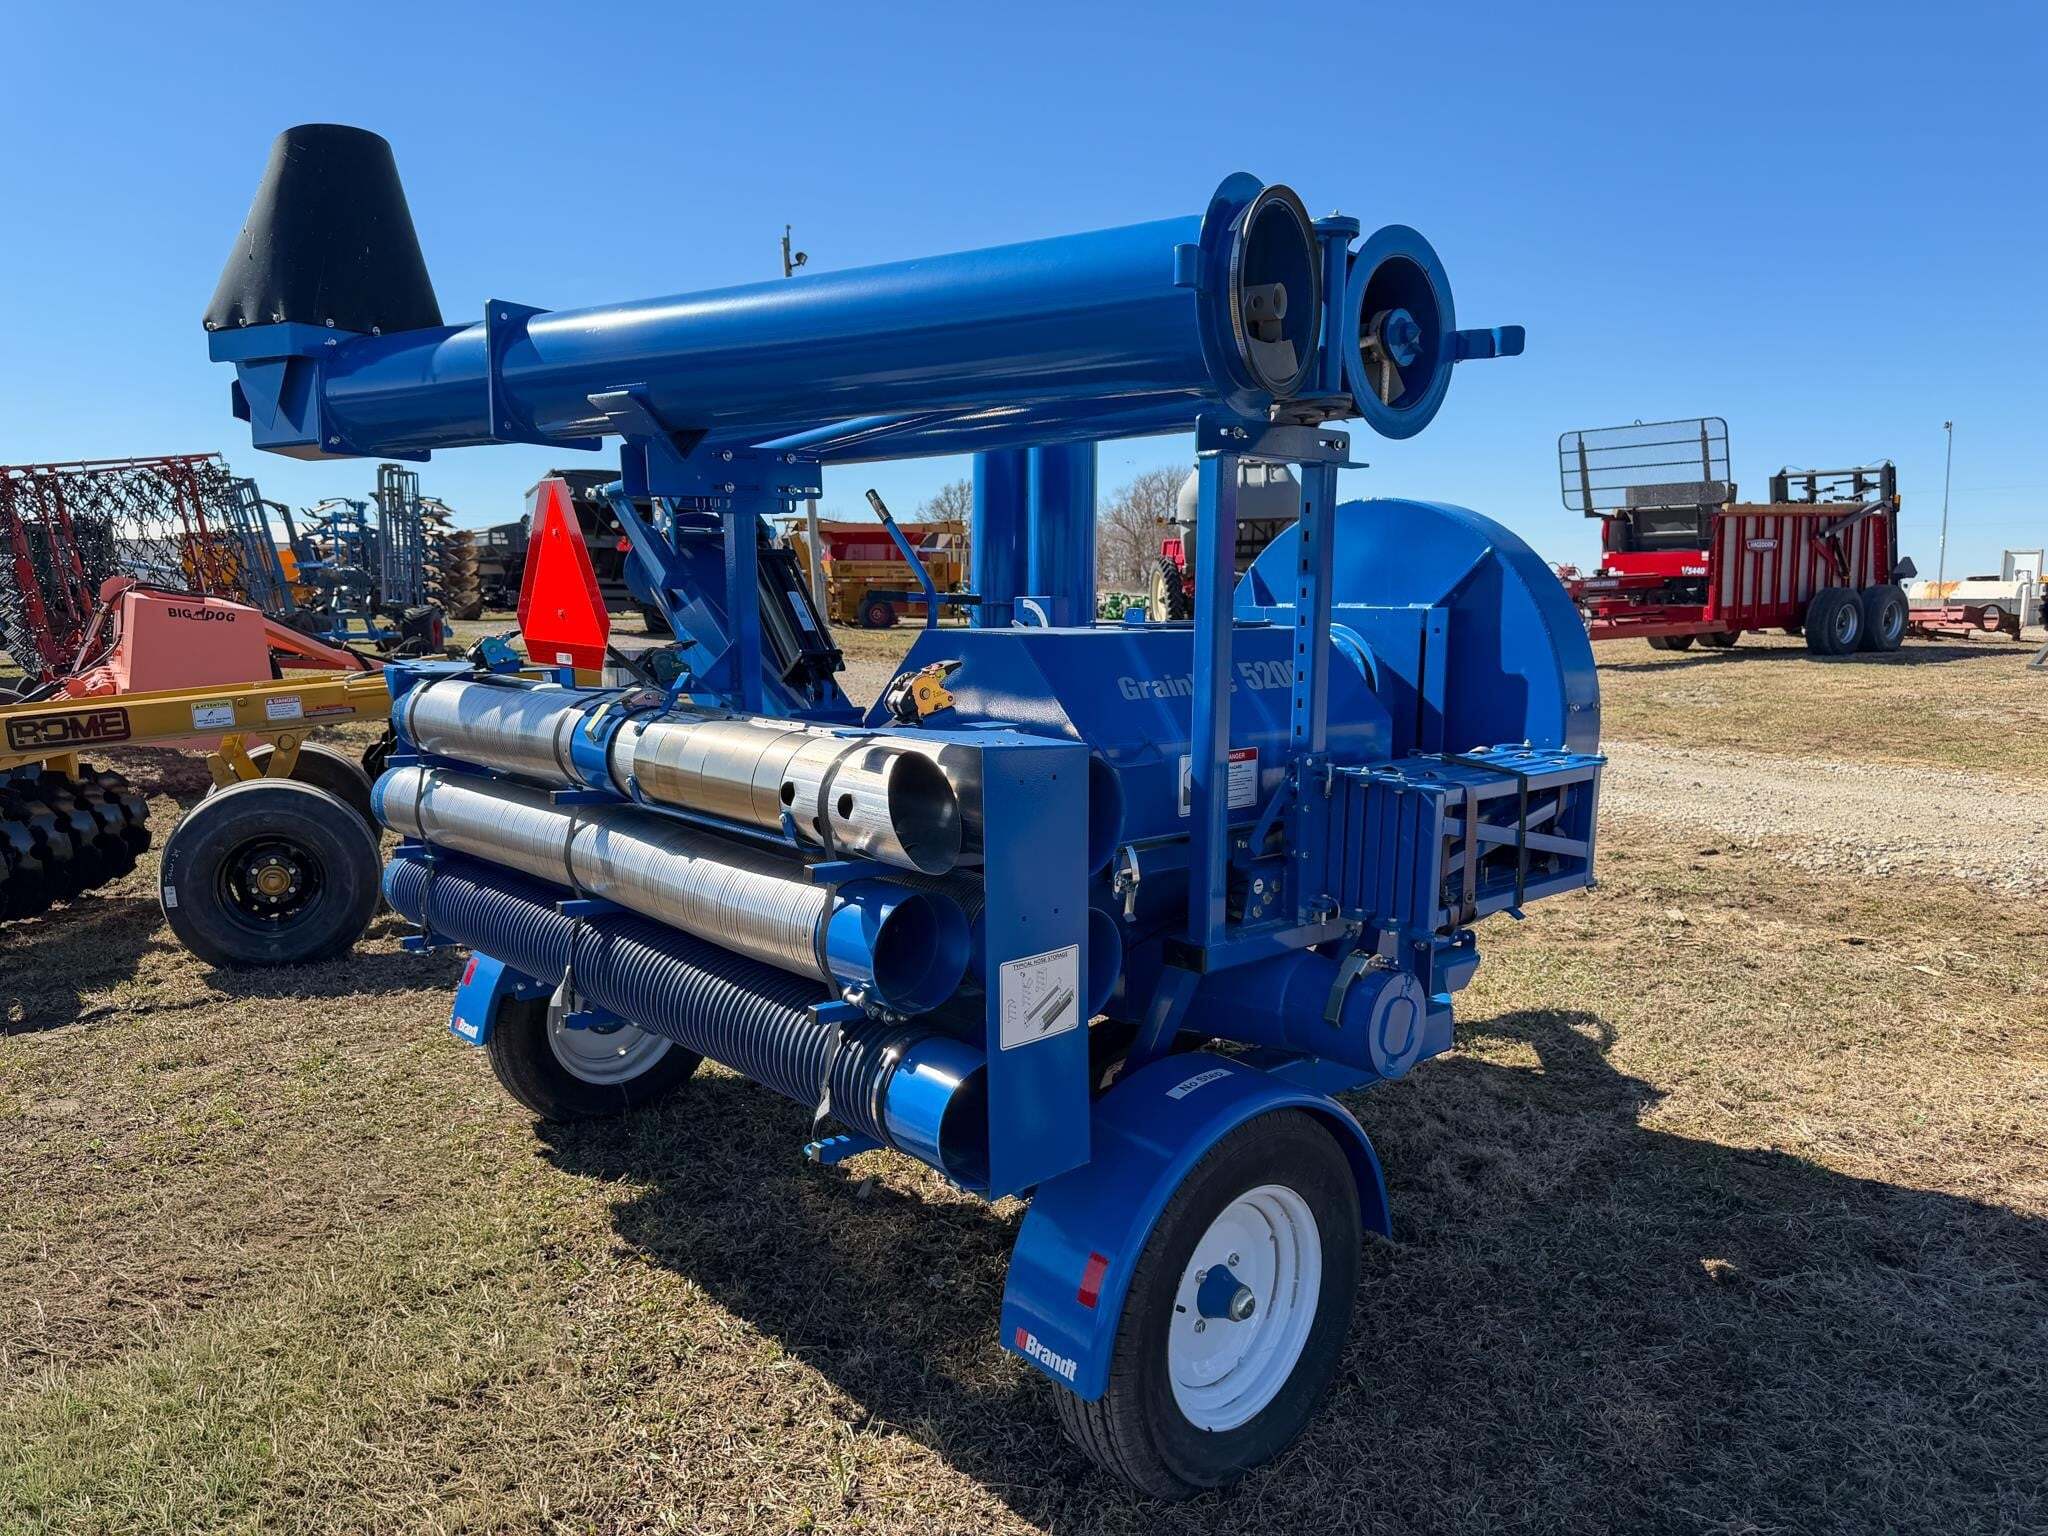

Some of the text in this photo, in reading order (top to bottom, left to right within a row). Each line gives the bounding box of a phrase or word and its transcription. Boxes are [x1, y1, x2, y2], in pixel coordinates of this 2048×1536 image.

[168, 608, 236, 622] BIG DOG
[15, 712, 122, 744] ROME
[1229, 752, 1245, 760] ANGER
[1013, 951, 1068, 970] TYPICAL HOSE STORAGE
[1179, 1071, 1223, 1091] No Step
[1025, 1333, 1077, 1382] Brandt
